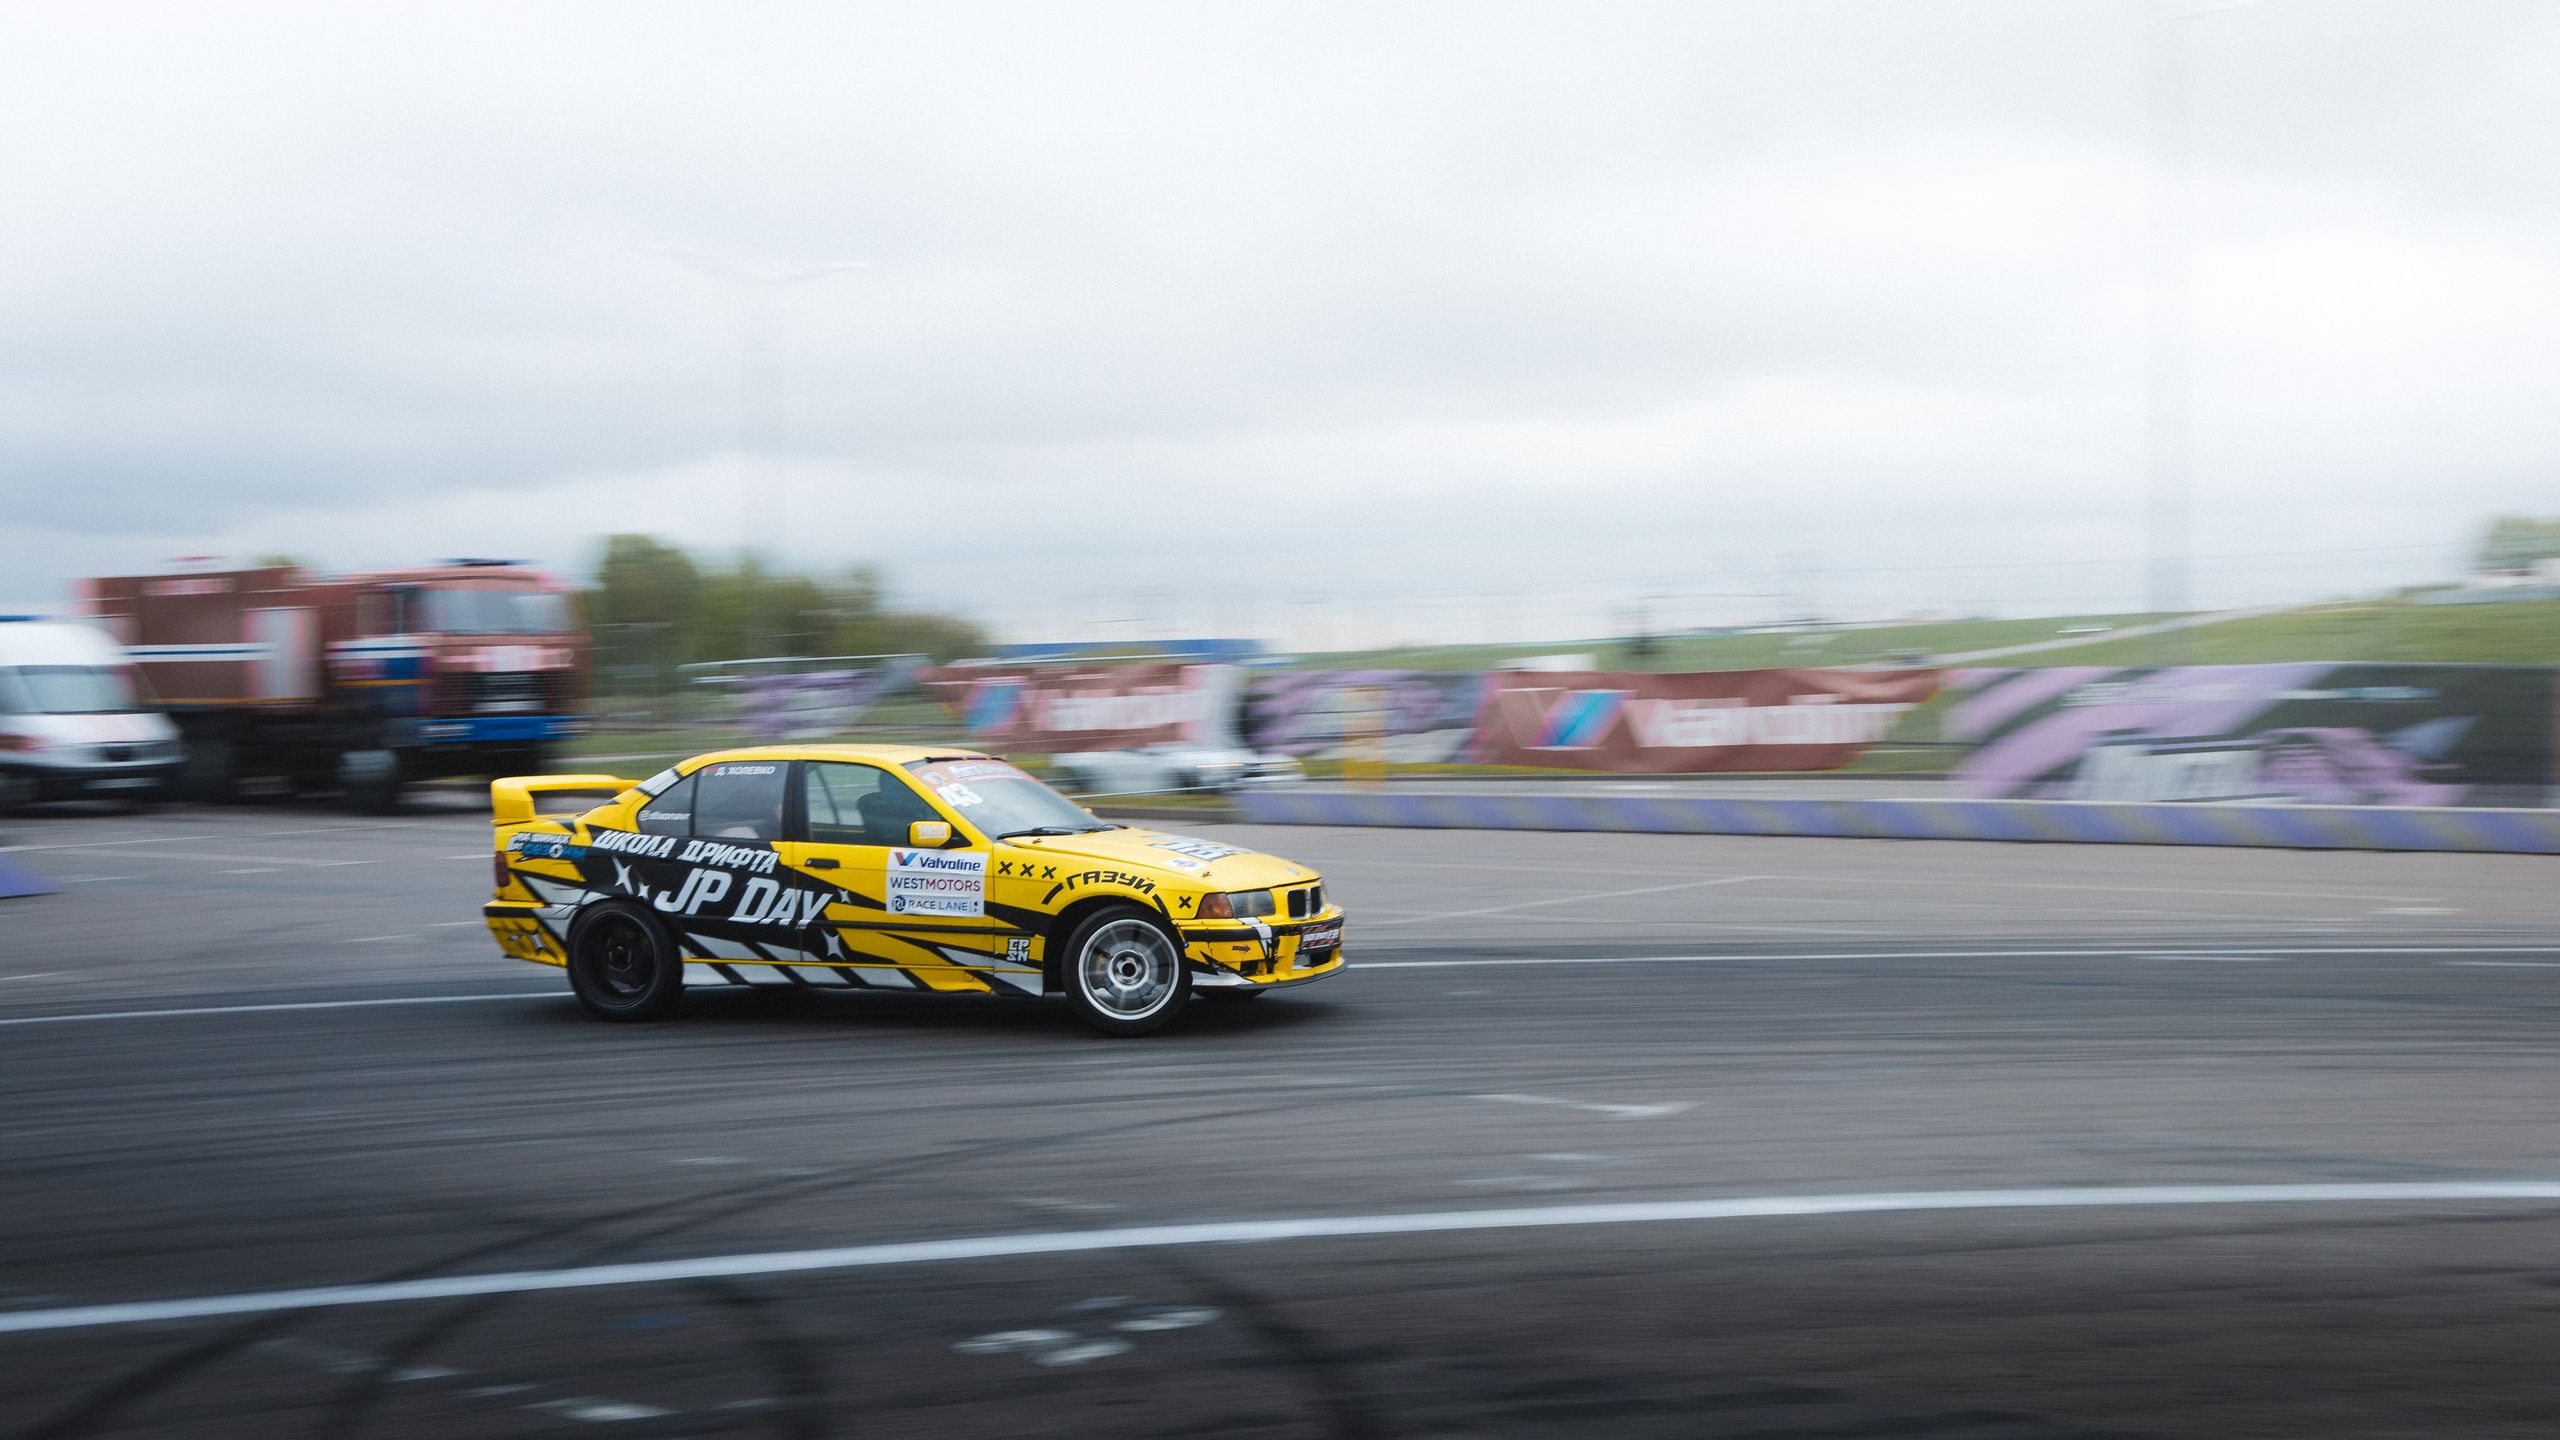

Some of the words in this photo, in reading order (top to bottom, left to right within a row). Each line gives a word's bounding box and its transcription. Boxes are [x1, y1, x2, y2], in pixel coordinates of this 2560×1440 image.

[591, 830, 677, 859] ШКОЛА
[677, 840, 781, 874] ДРИФТА
[920, 857, 981, 872] Valvoline
[653, 867, 733, 916] JP
[890, 877, 981, 892] WESTMOTORS
[1066, 870, 1156, 895] ГАЗУЙ
[908, 899, 936, 910] RACE
[938, 901, 968, 911] LANE
